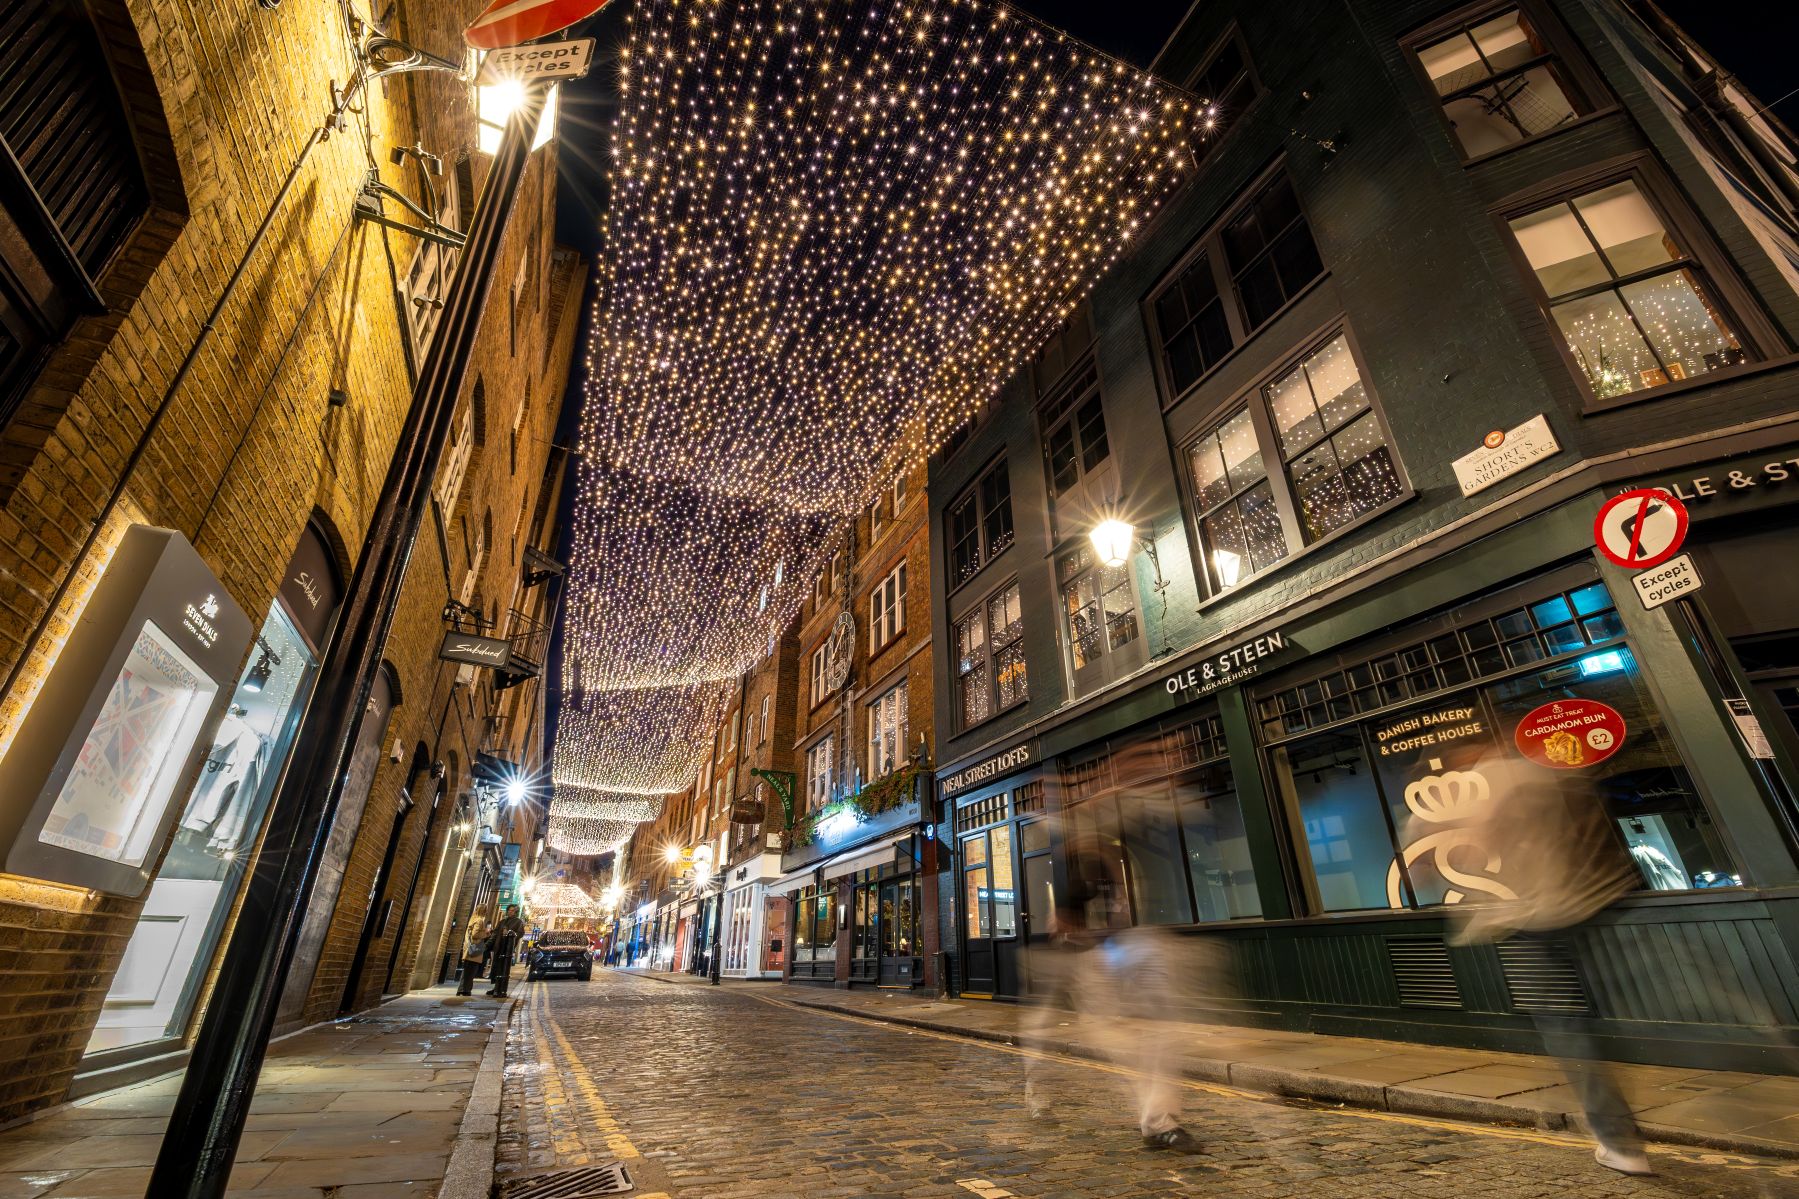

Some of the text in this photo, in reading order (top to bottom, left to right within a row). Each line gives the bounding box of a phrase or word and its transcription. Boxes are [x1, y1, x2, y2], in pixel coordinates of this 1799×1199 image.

[496, 45, 580, 63] Except
[496, 60, 571, 75] cles
[1464, 441, 1554, 491] GARDENS WC2
[1474, 440, 1533, 475] SHORT'S
[1728, 470, 1756, 488] &
[1639, 561, 1688, 589] Except
[1649, 577, 1691, 601] cycles
[185, 604, 204, 628] SEVEN
[201, 621, 218, 642] DIALS
[448, 643, 504, 659] Subdued
[1166, 631, 1283, 694] OLE & STEEN
[1196, 664, 1258, 694] LAGKAGEHUSET
[1377, 708, 1473, 742] DANISH BAKERY
[1525, 712, 1606, 738] CARDAMOM BUN
[1536, 715, 1553, 724] MUST
[1565, 707, 1584, 717] TREAT
[1380, 722, 1483, 756] & COFFEE HOUSE
[1591, 733, 1610, 745] £2
[942, 745, 1029, 795] NEAL STREET LOFTS
[781, 792, 791, 810] YARD
